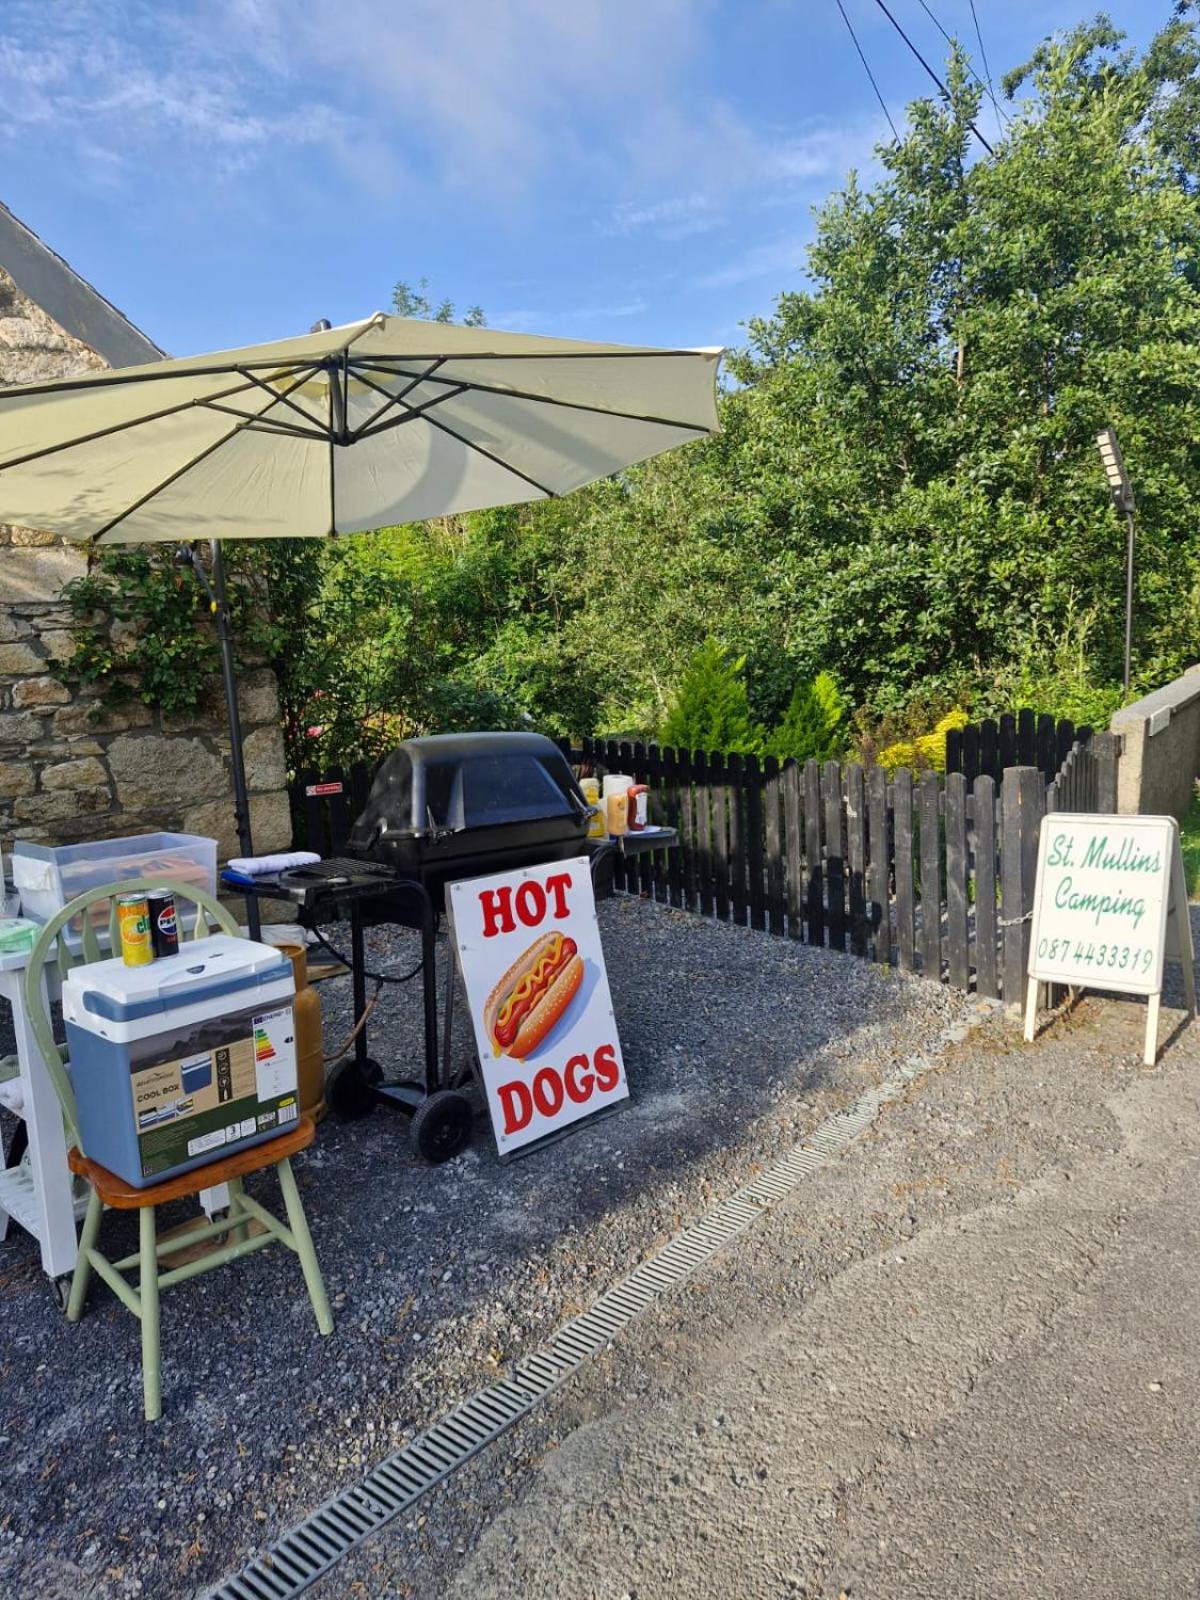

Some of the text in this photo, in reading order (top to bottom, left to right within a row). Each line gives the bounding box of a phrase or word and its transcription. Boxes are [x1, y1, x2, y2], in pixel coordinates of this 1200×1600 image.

[1047, 834, 1161, 873] St. Mullins
[478, 873, 573, 938] HOT
[1055, 876, 1145, 929] Camping
[137, 1083, 180, 1103] COOL BOX
[497, 1044, 619, 1135] DOGS
